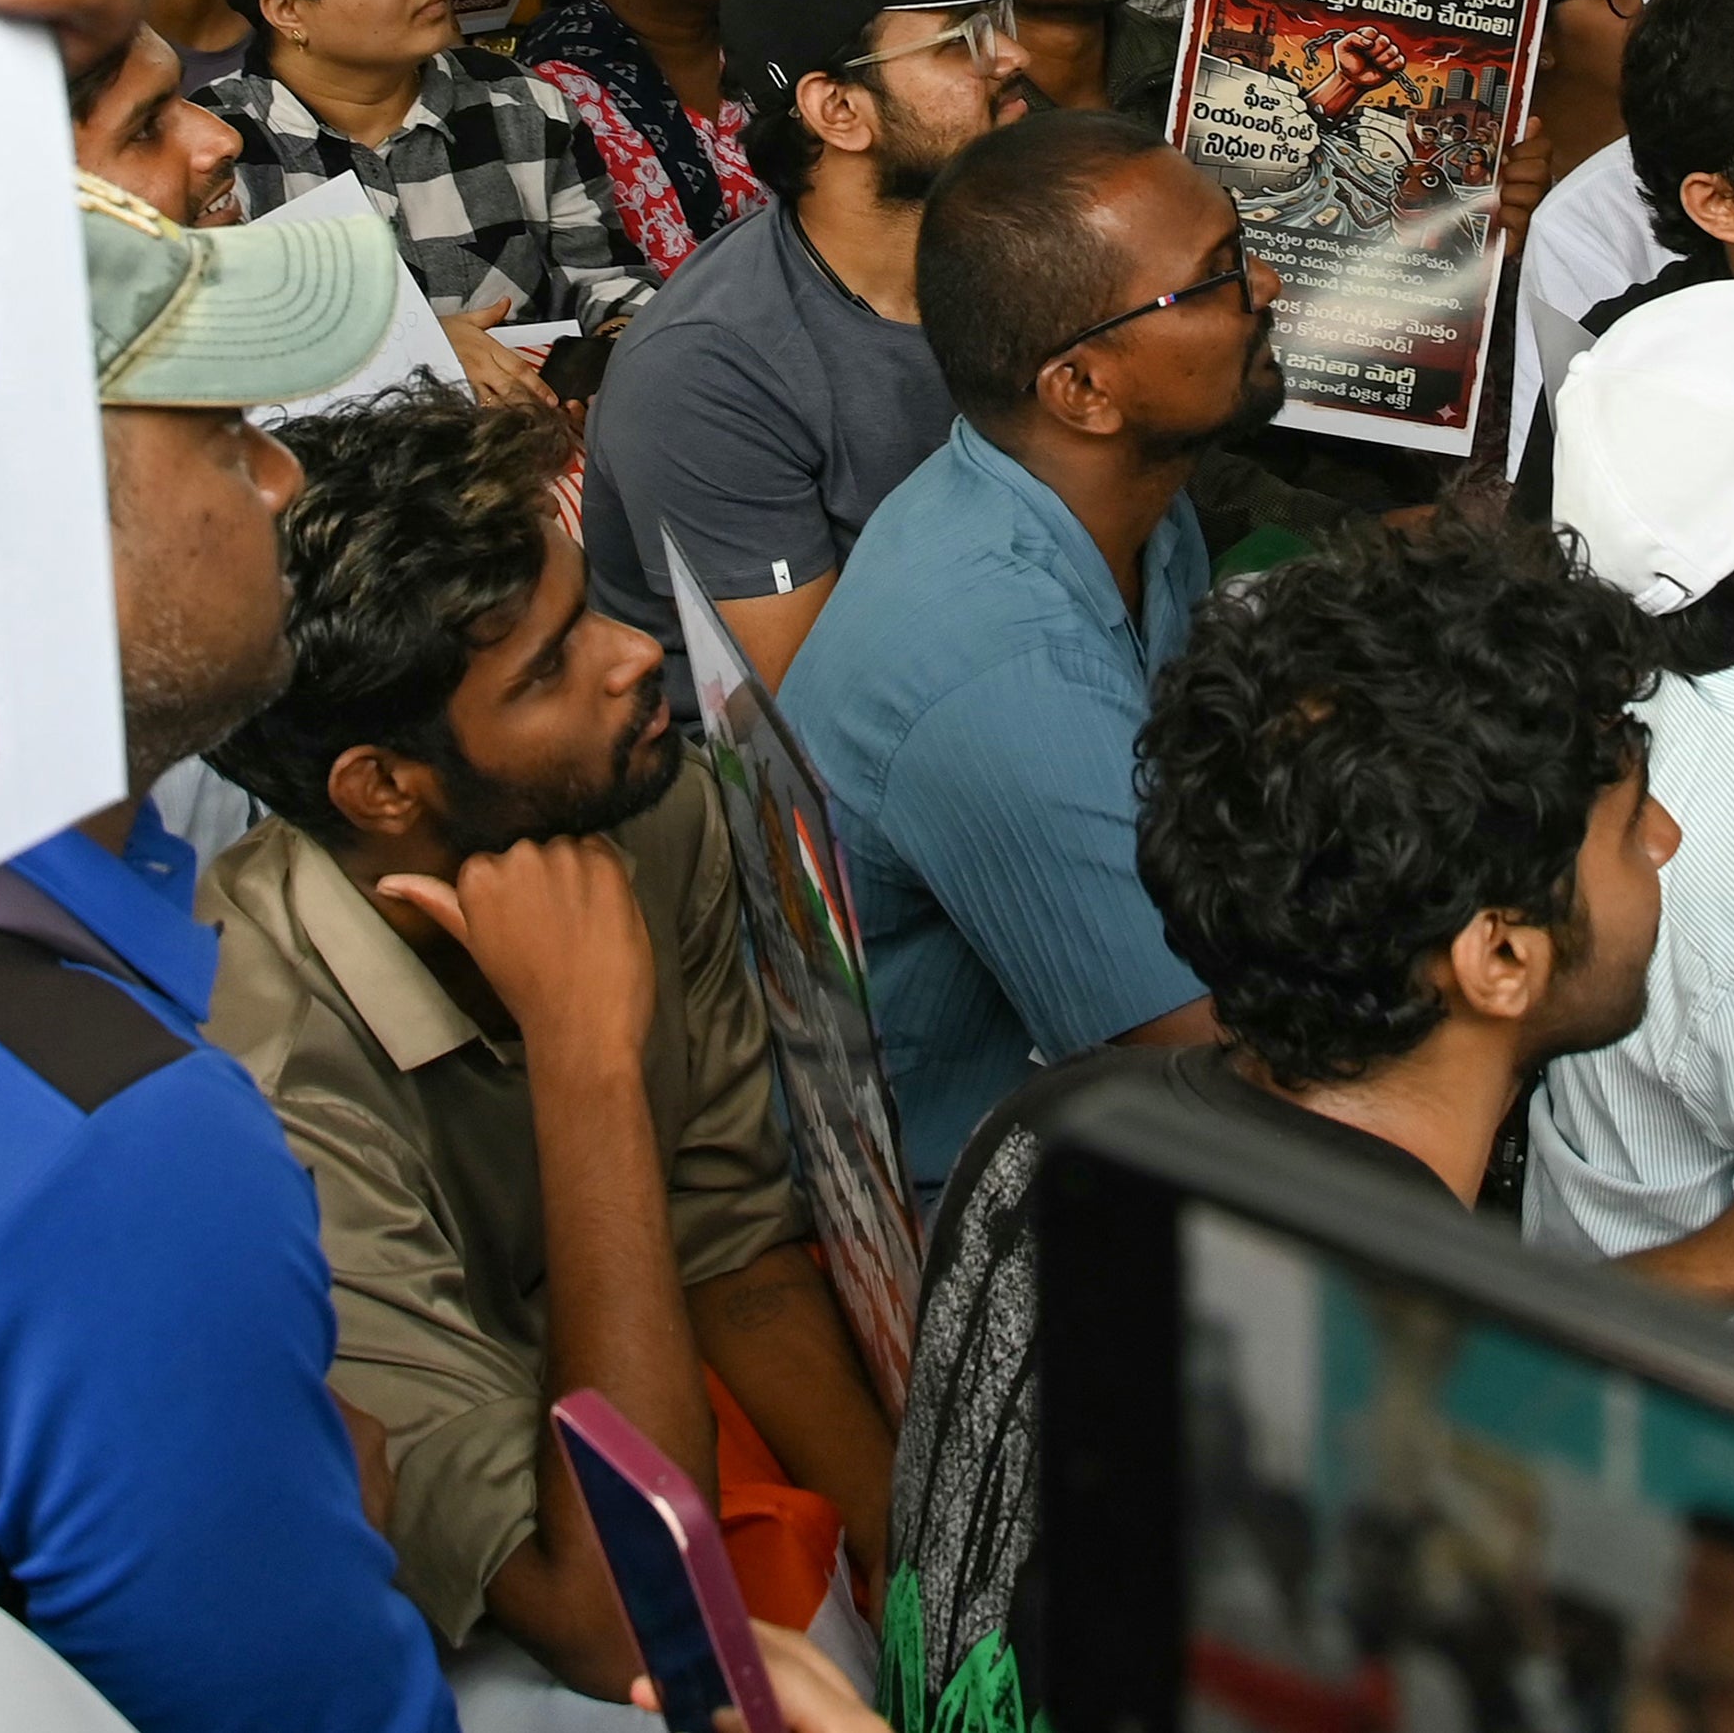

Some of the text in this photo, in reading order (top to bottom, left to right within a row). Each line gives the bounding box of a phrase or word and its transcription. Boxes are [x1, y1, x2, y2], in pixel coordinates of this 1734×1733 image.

[1437, 3, 1515, 37] చేయాలి!
[1244, 83, 1280, 111] ఫీజు
[1205, 132, 1300, 163] నిధుల గోడ
[1405, 319, 1458, 344] మొత్తం
[1286, 352, 1360, 377] జనతా
[1365, 365, 1416, 394] పార్టీ
